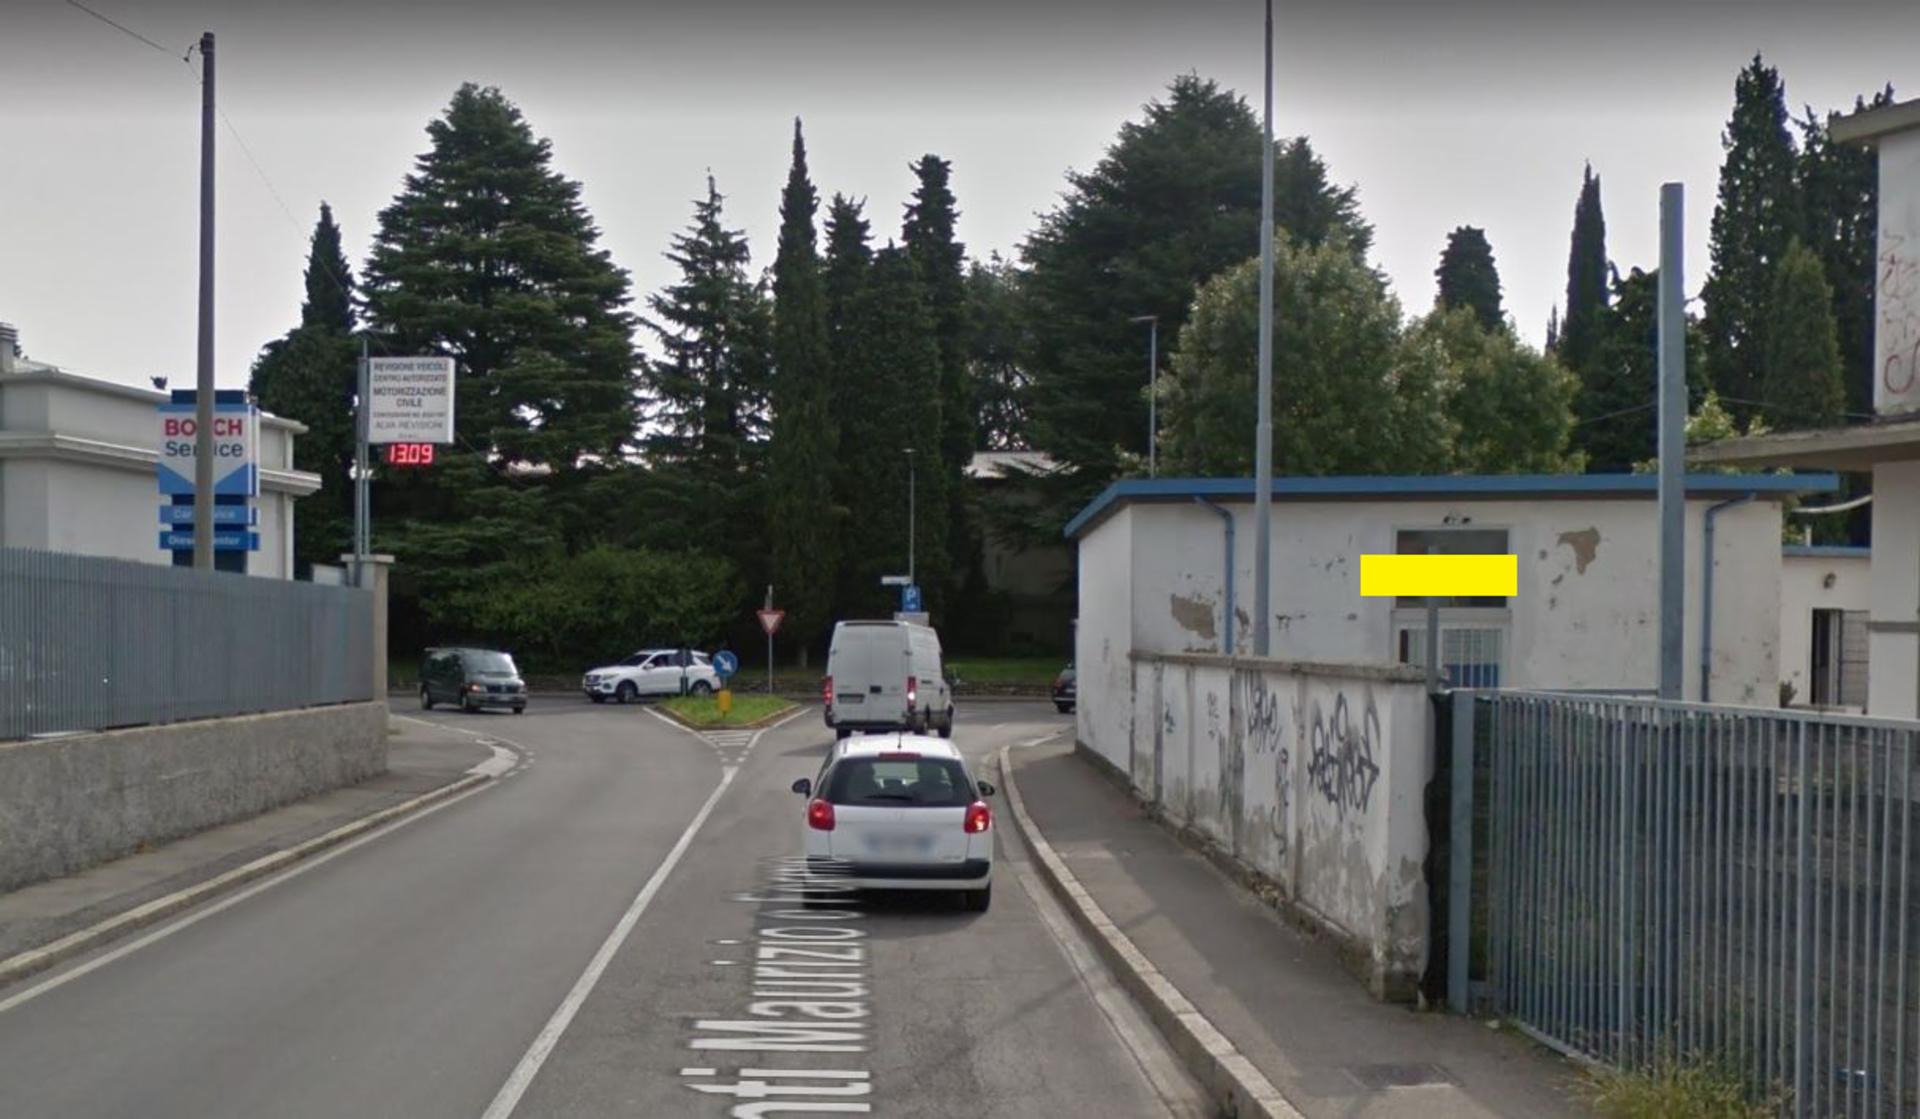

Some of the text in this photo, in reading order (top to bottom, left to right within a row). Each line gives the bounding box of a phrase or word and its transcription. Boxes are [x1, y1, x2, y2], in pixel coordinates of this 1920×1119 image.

[374, 387, 447, 396] MOTORIZZAZIONE
[396, 398, 422, 408] CIVILE
[165, 419, 242, 436] BOCH
[165, 441, 243, 457] Serice
